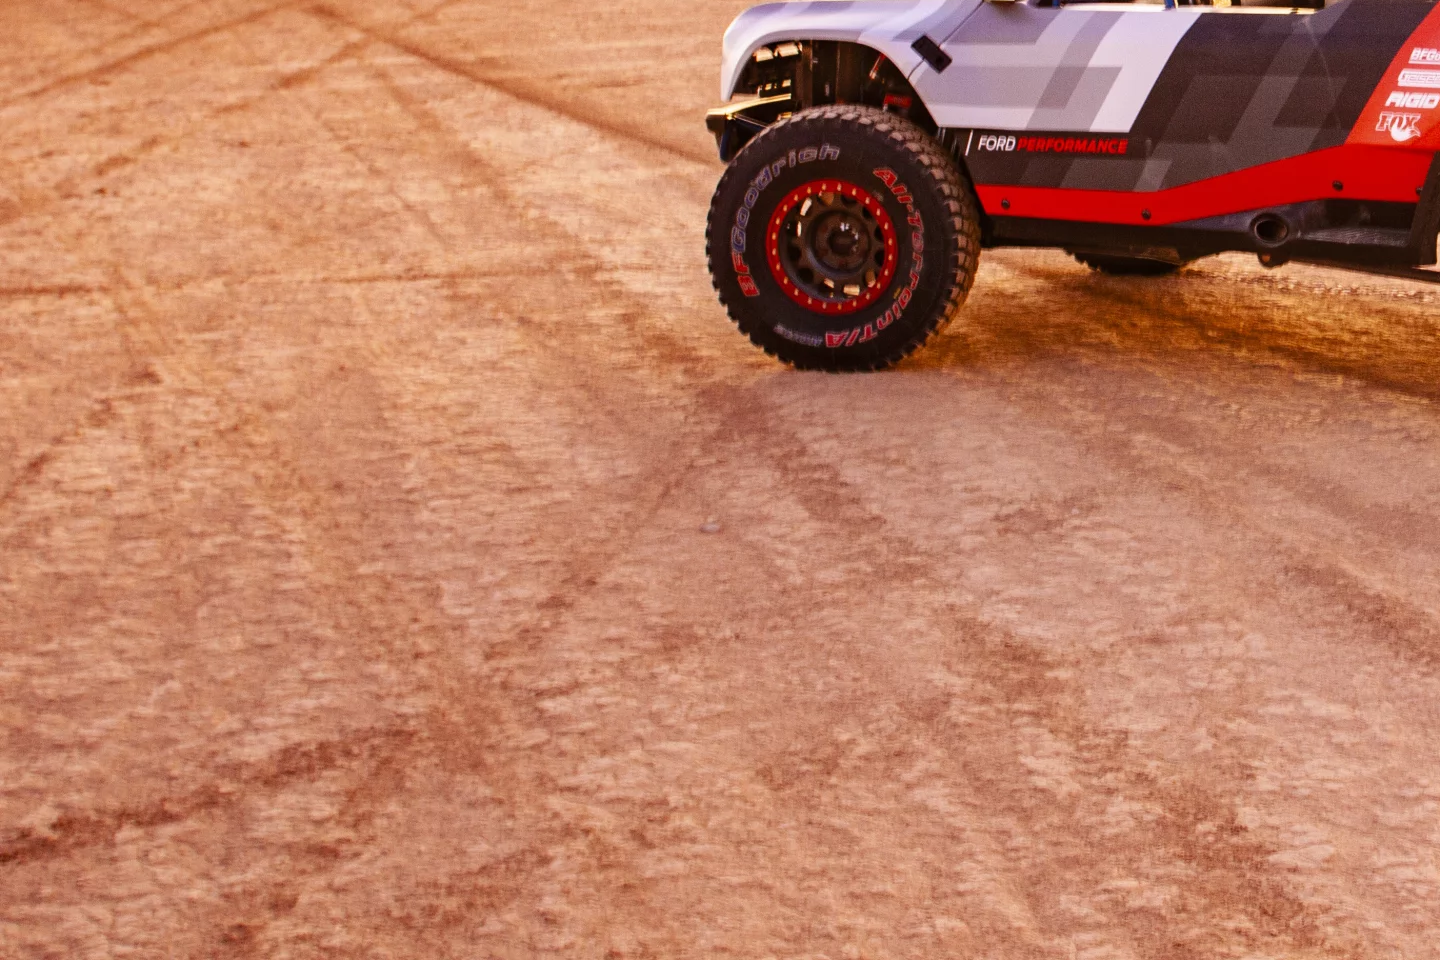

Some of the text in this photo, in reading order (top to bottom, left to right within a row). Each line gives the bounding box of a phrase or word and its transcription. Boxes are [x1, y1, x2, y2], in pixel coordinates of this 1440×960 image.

[1385, 91, 1440, 109] RIGID
[1375, 111, 1422, 138] FOX
[978, 135, 1128, 154] FORD PERFORMANCE
[731, 143, 840, 297] BFGoodrich
